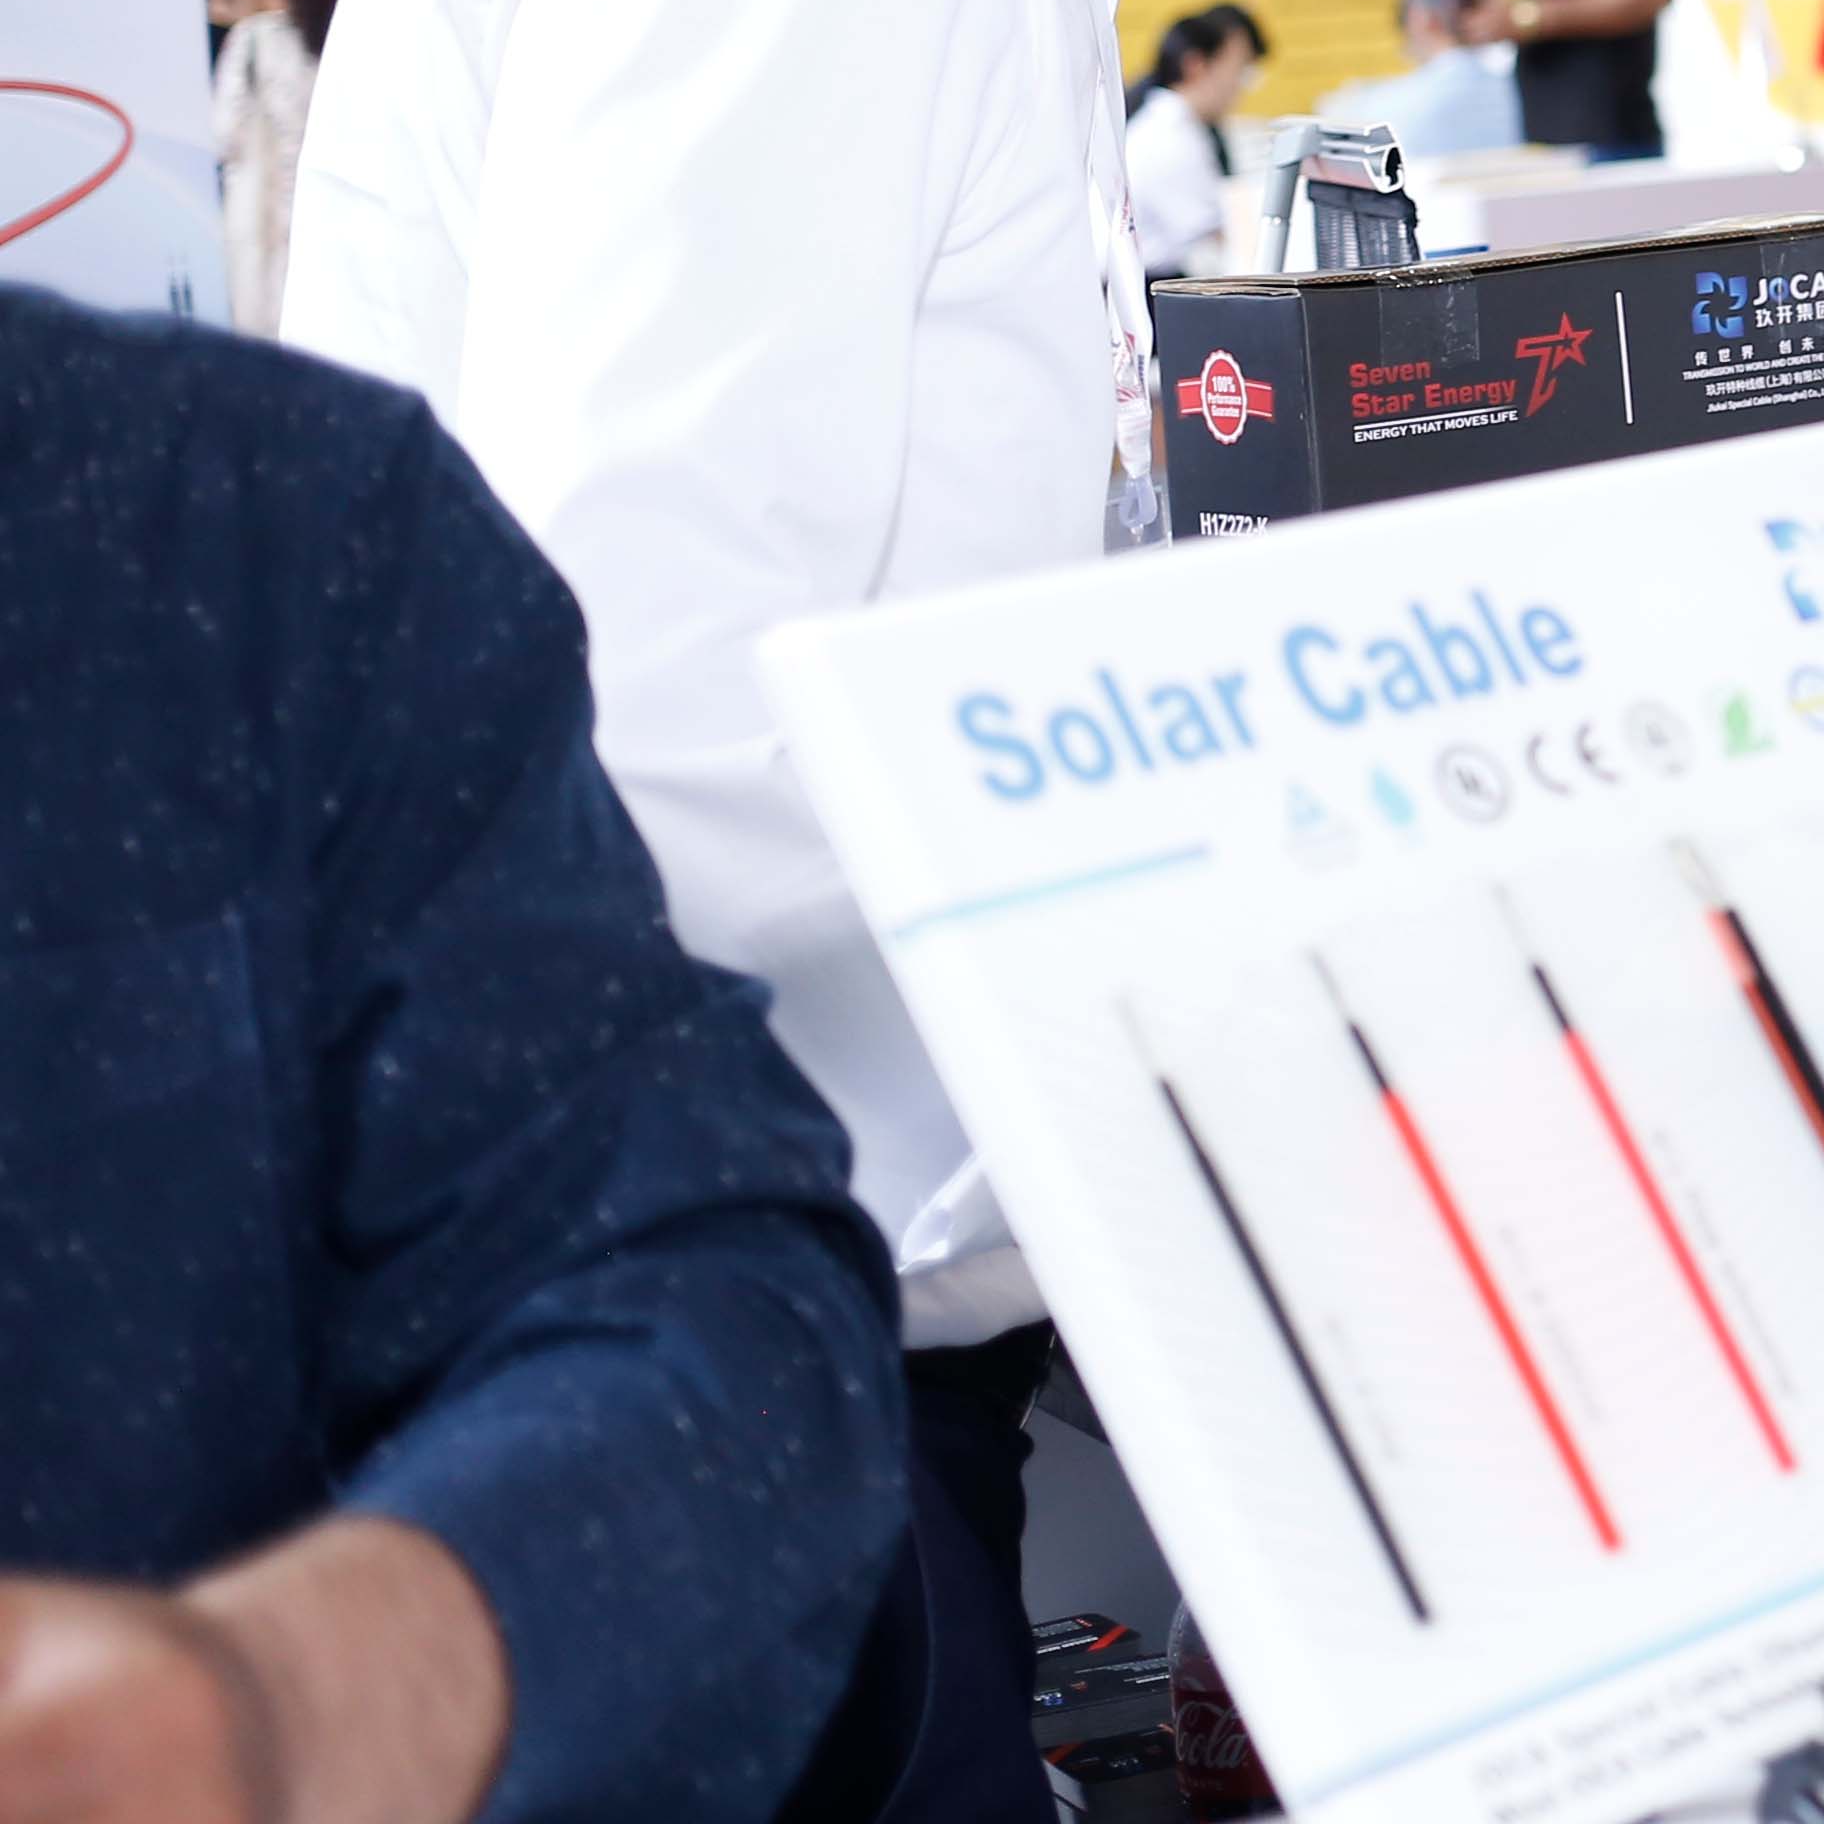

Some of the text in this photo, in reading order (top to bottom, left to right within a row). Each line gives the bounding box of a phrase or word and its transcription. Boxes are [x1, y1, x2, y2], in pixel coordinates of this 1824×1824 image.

[1349, 360, 1432, 389] Seven
[1745, 360, 1770, 372] WORLD
[1771, 358, 1787, 369] AND
[1211, 375, 1237, 393] 100%
[1351, 378, 1518, 419] Star Energy
[1354, 409, 1519, 444] ENERGY THAT MOVES LIFE
[953, 586, 1586, 803] Solar Cable
